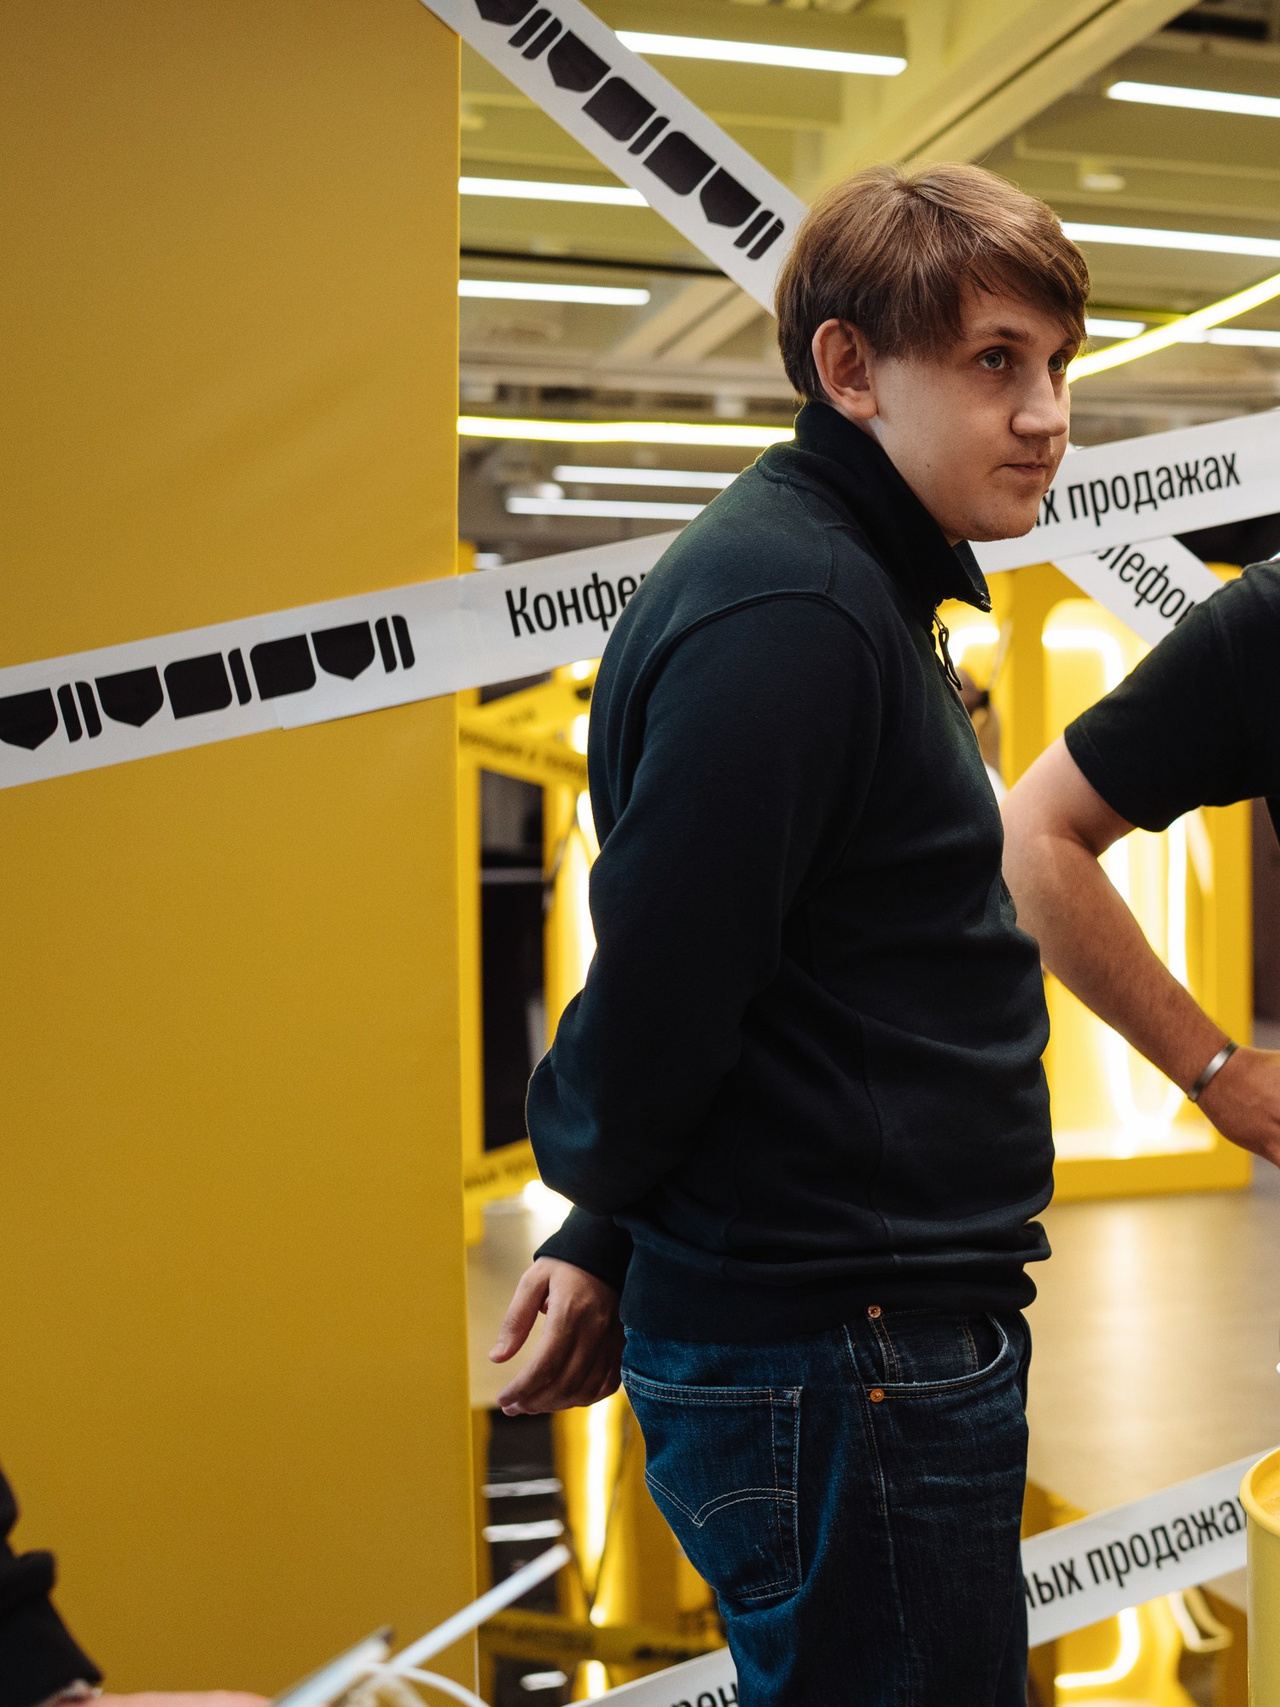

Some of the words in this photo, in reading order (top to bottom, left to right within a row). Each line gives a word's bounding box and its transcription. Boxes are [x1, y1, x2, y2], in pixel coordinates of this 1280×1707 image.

[505, 572, 646, 637] Конфе
[1037, 489, 1060, 526] х
[1067, 452, 1240, 527] продажах
[1092, 544, 1195, 627] лефо
